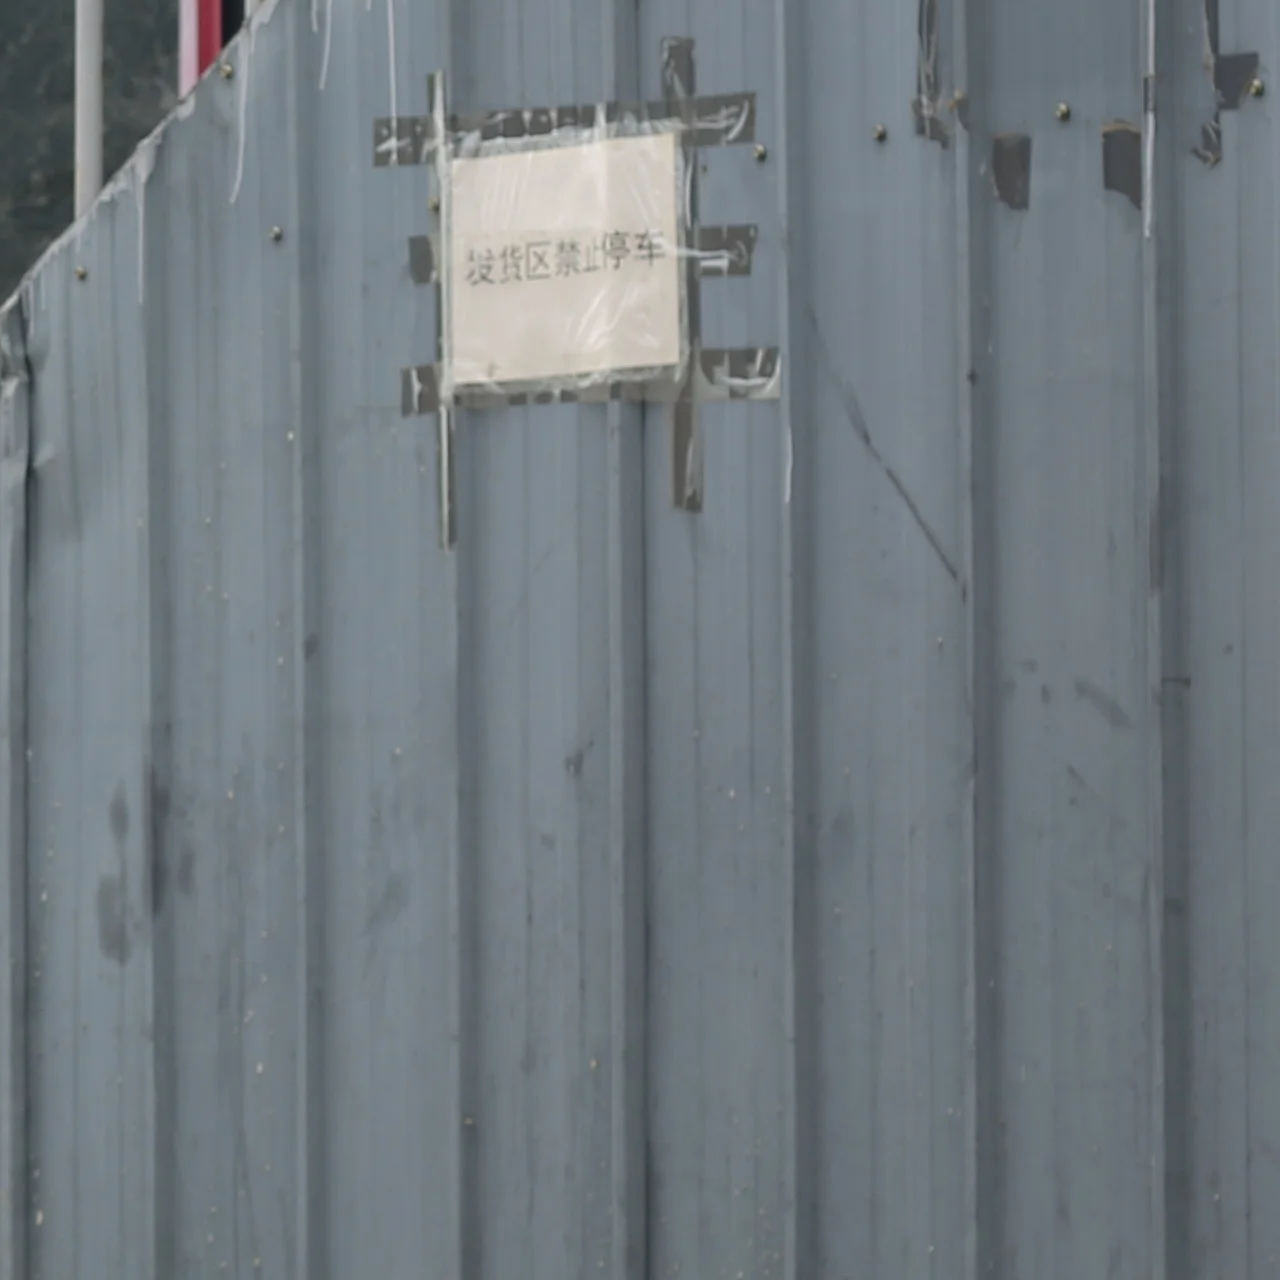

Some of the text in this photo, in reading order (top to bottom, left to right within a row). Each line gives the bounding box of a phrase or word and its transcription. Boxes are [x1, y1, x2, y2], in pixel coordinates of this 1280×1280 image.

[466, 230, 668, 287] 发货区禁止停车
